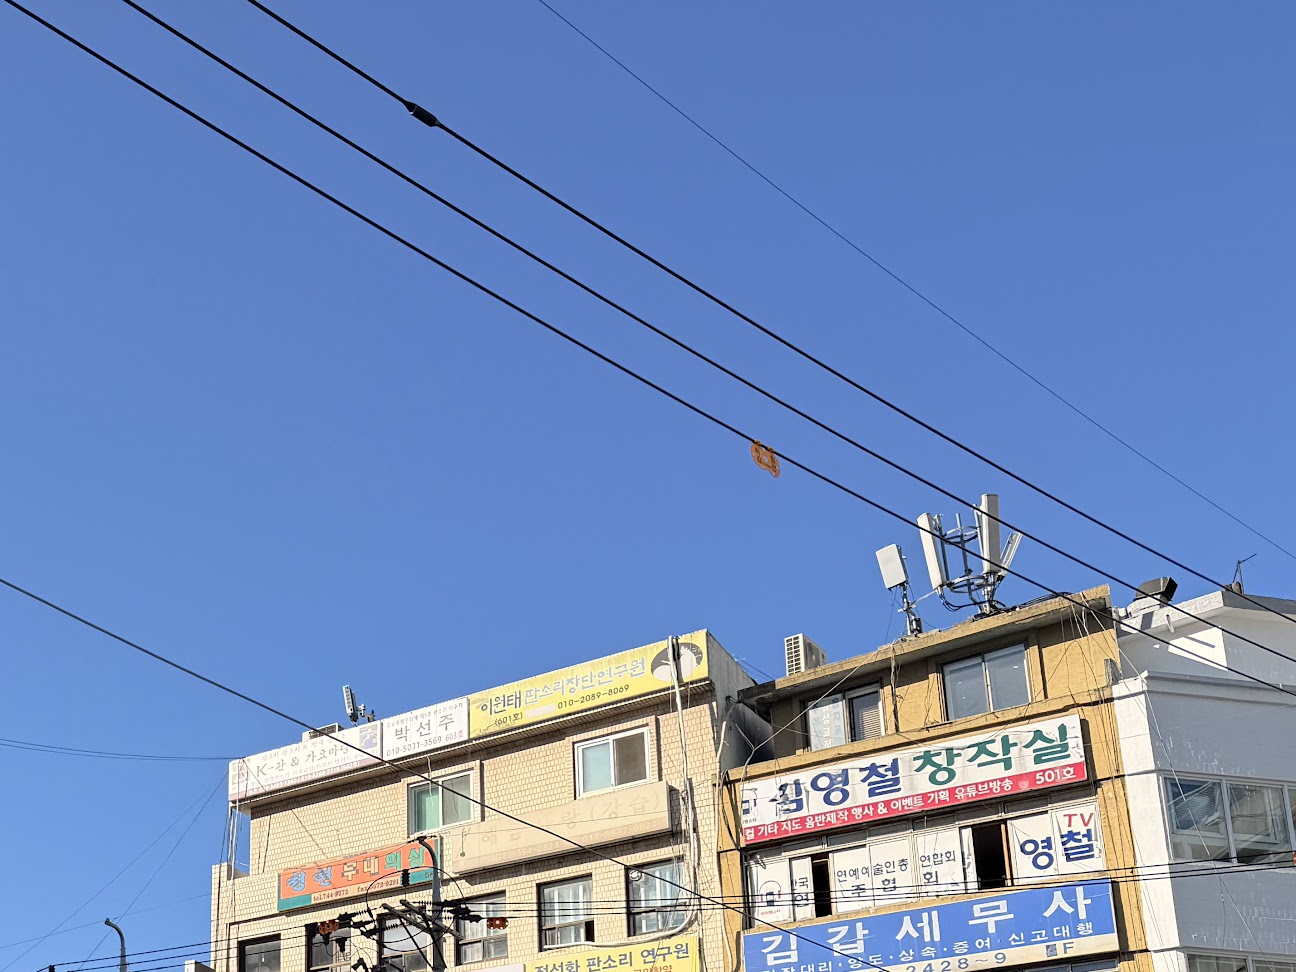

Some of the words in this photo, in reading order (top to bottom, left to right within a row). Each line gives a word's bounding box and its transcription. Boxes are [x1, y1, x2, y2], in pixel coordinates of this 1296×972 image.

[480, 690, 521, 715] 이원태
[524, 656, 646, 704] 판소리장단연구원
[494, 712, 523, 727] (601호)
[557, 684, 630, 710] 010-2089-8069
[386, 736, 442, 757] 010-5031-3569
[445, 731, 464, 743] 603호
[394, 712, 455, 743] 박선주
[912, 723, 1072, 786] 창작실
[757, 822, 779, 838] 기타
[781, 818, 802, 833] 지도
[805, 810, 848, 829] 음반제작
[852, 807, 873, 820] 행사
[877, 804, 888, 814] &
[891, 796, 925, 811] 이벤트
[927, 789, 950, 804] 기획
[954, 778, 1013, 799] 유튜브방송
[1035, 766, 1077, 785] 501호
[1063, 812, 1094, 828] TV
[1020, 828, 1096, 871] 영철
[586, 951, 633, 972] 판소리
[640, 943, 690, 965] 연구원
